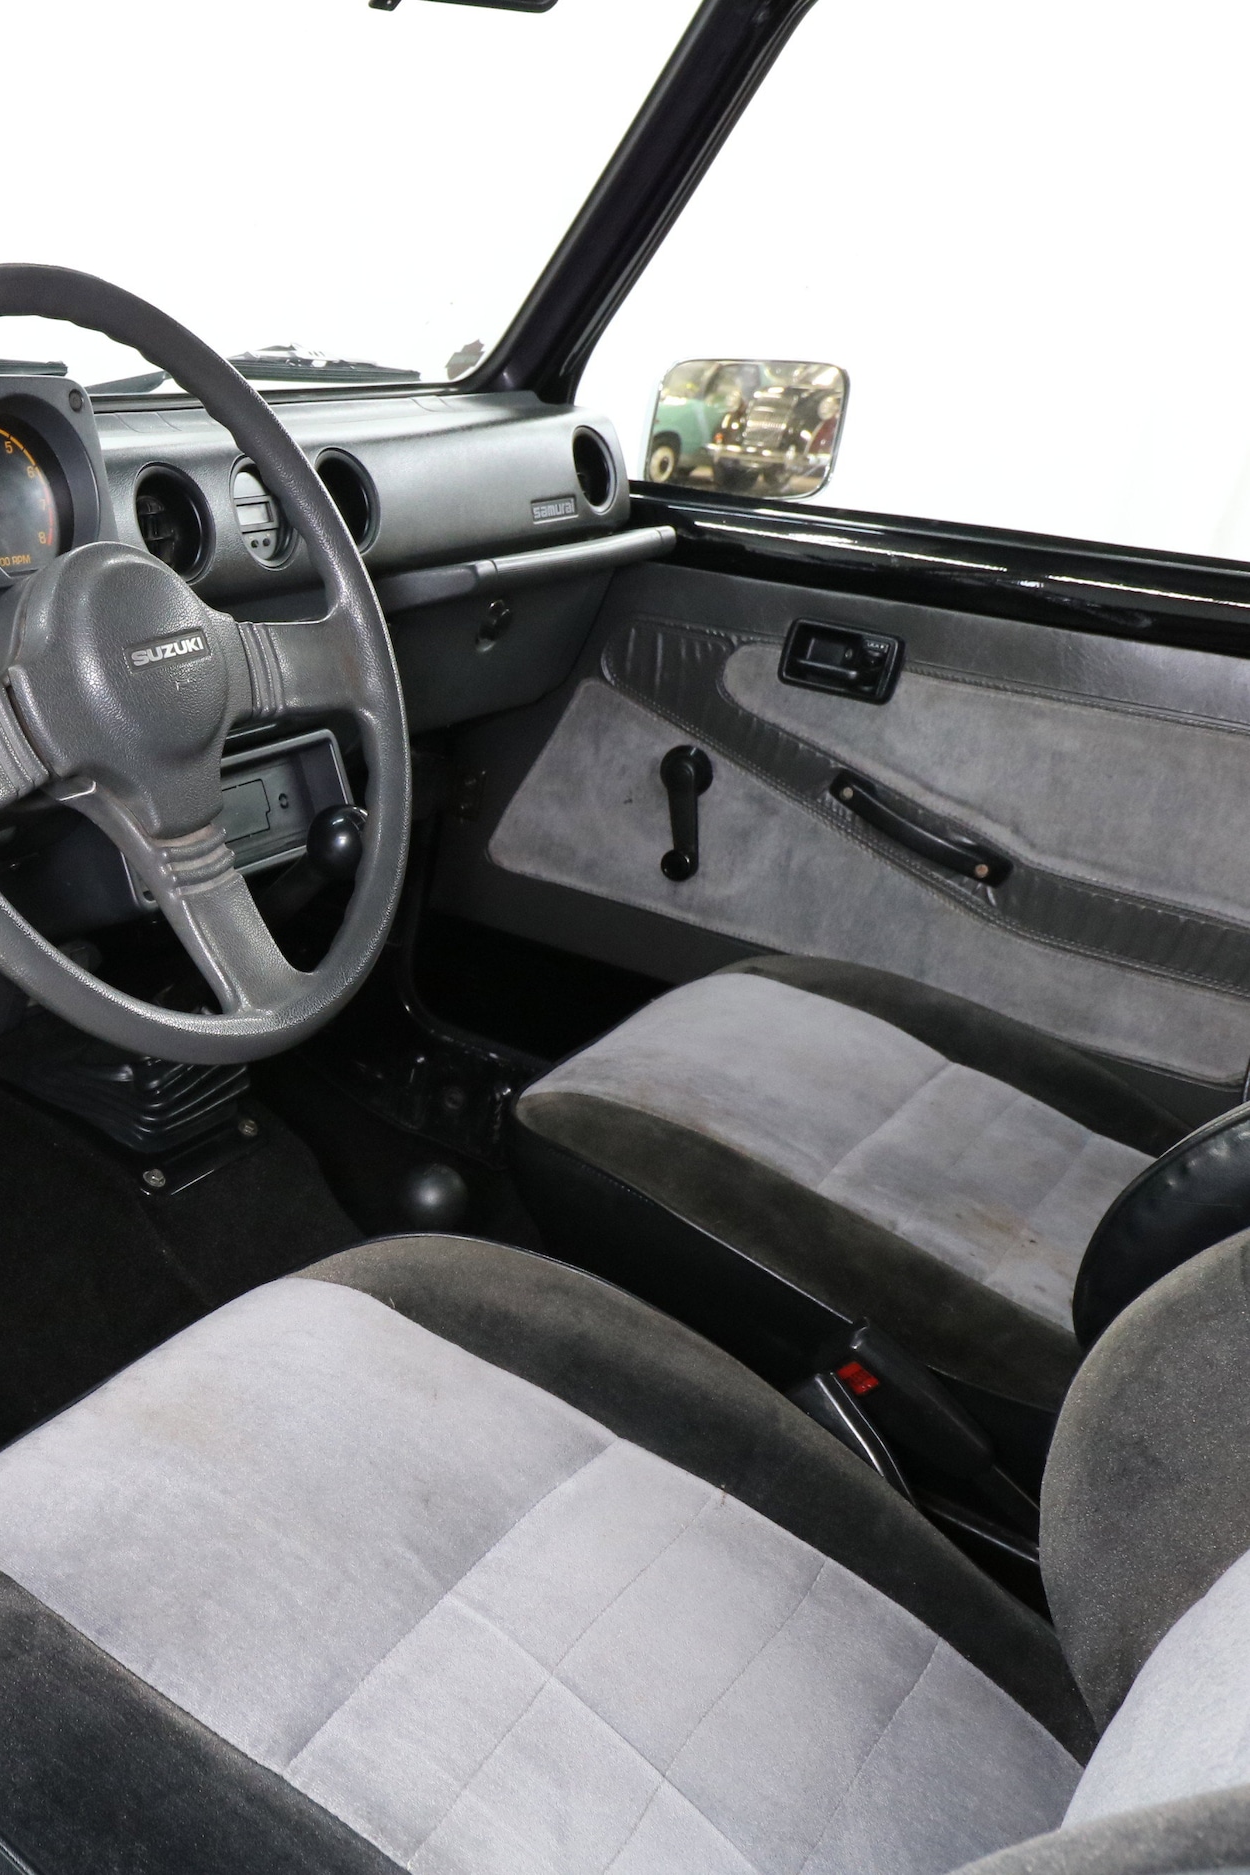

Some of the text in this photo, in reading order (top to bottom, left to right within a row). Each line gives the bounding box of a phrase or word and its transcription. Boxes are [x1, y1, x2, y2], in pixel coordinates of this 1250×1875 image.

[4, 441, 13, 454] 5
[27, 465, 36, 478] 6
[38, 531, 47, 544] 8
[11, 554, 32, 566] RPM
[131, 636, 204, 667] SUZUKI
